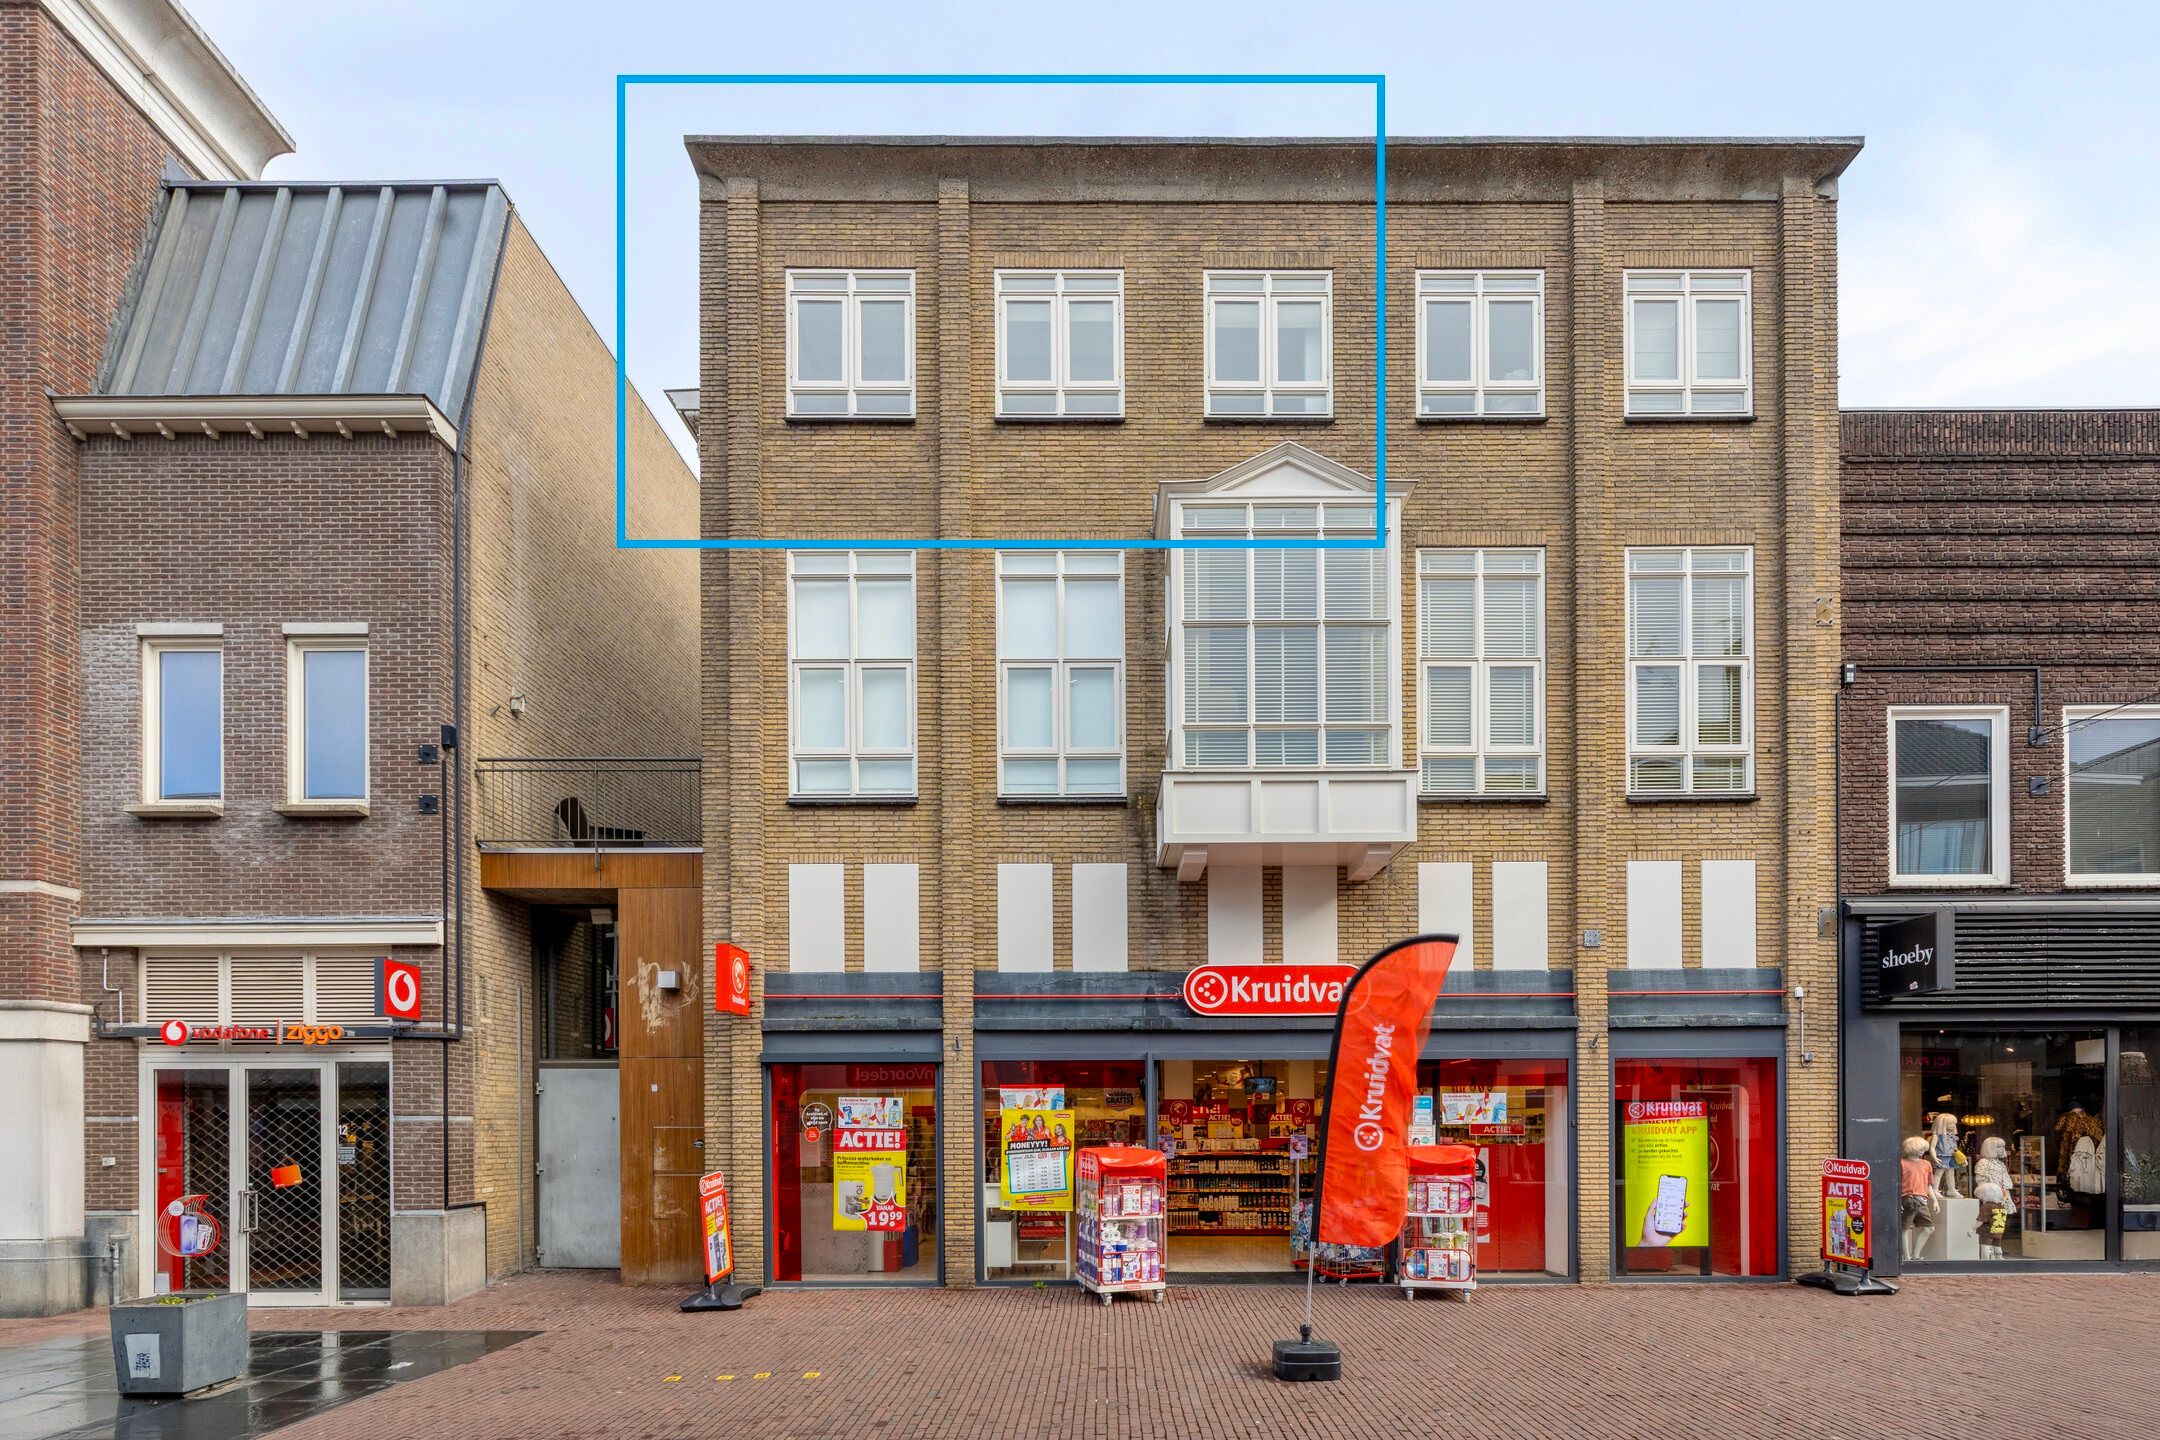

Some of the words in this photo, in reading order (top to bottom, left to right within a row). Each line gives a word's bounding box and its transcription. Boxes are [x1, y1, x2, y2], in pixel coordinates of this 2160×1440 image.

[1882, 944, 1934, 968] shoeby
[1231, 975, 1352, 1002] Kruidva
[192, 1024, 269, 1040] vodafone
[286, 1021, 343, 1045] ziggo
[1359, 1024, 1395, 1120] Kruidvat
[1646, 1102, 1702, 1116] Kruidvat
[338, 1124, 348, 1135] 12
[1680, 1126, 1697, 1134] APP
[840, 1131, 901, 1148] ACTIE!
[1010, 1140, 1048, 1150] MONEYYY!
[1833, 1163, 1866, 1175] Kruidvat
[1828, 1182, 1864, 1197] ACTIE!
[1848, 1199, 1863, 1210] 1+1
